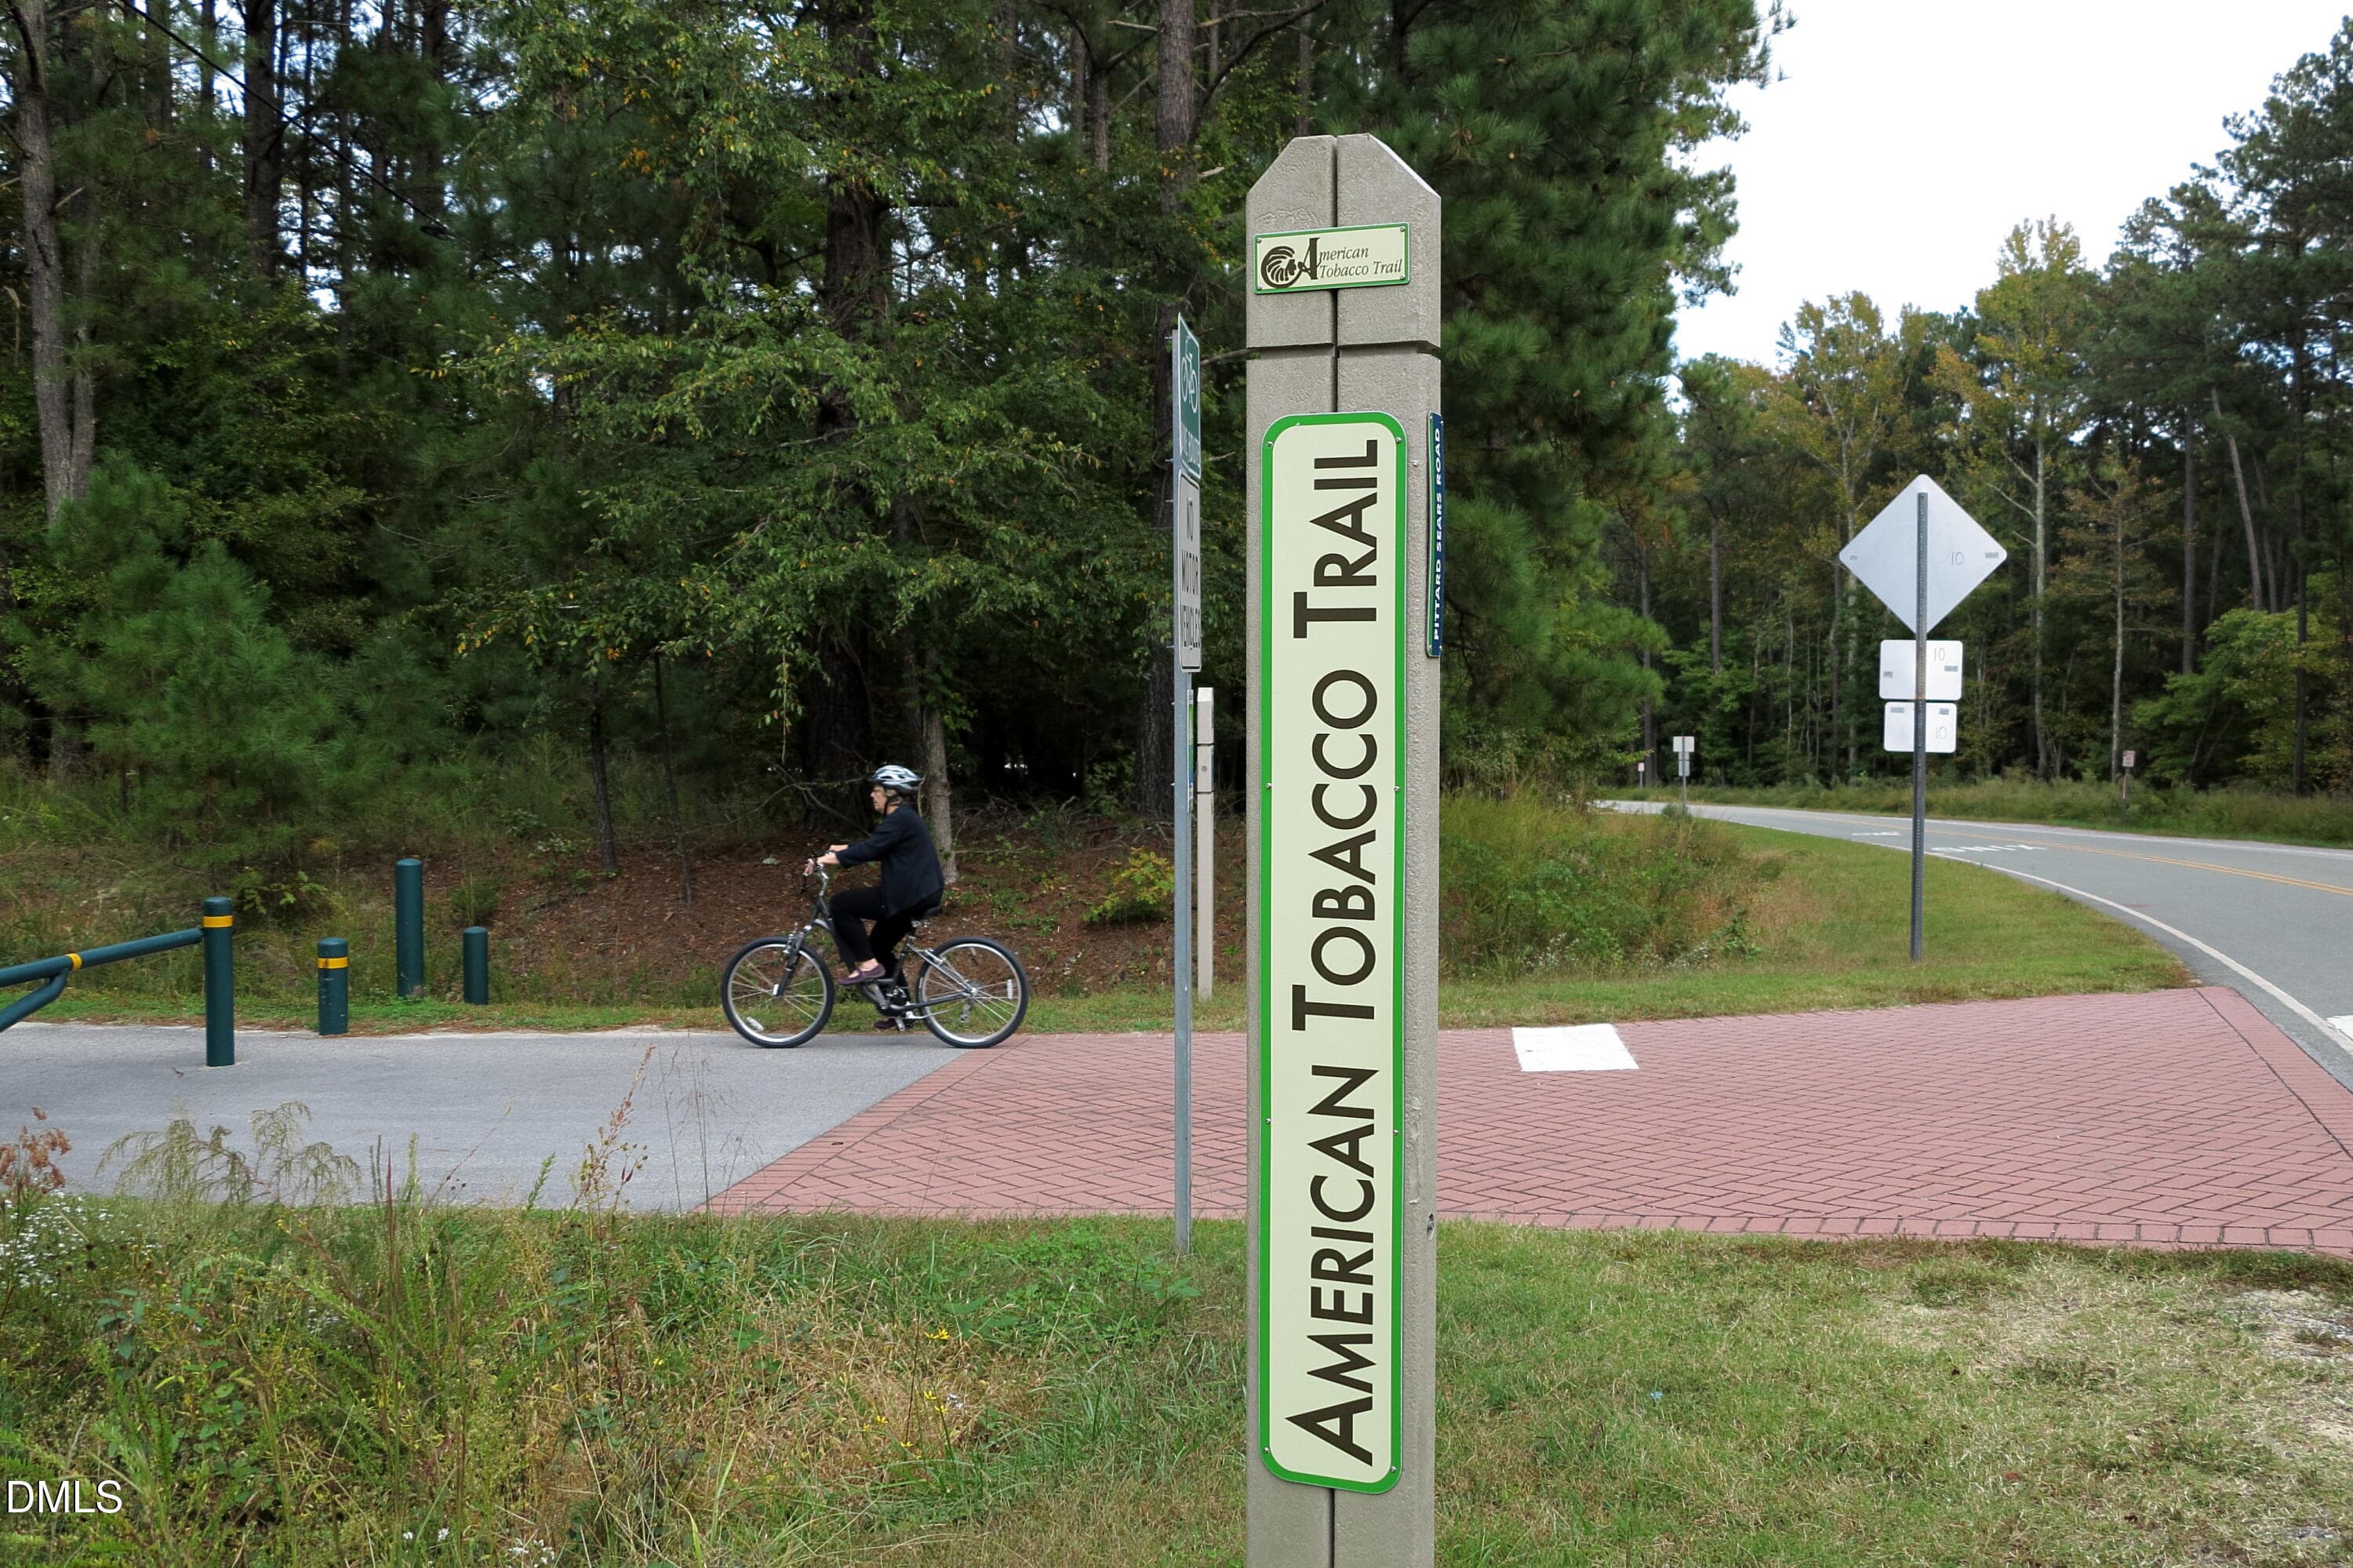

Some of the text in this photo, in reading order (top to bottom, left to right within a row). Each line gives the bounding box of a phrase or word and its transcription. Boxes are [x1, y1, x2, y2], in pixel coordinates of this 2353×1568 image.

[1319, 259, 1402, 278] Tobacco Trail
[1181, 549, 1199, 595] MOTOR
[1433, 558, 1442, 640] PITTARD
[1286, 440, 1378, 1466] AMERICAN TOBACCO TRAIL
